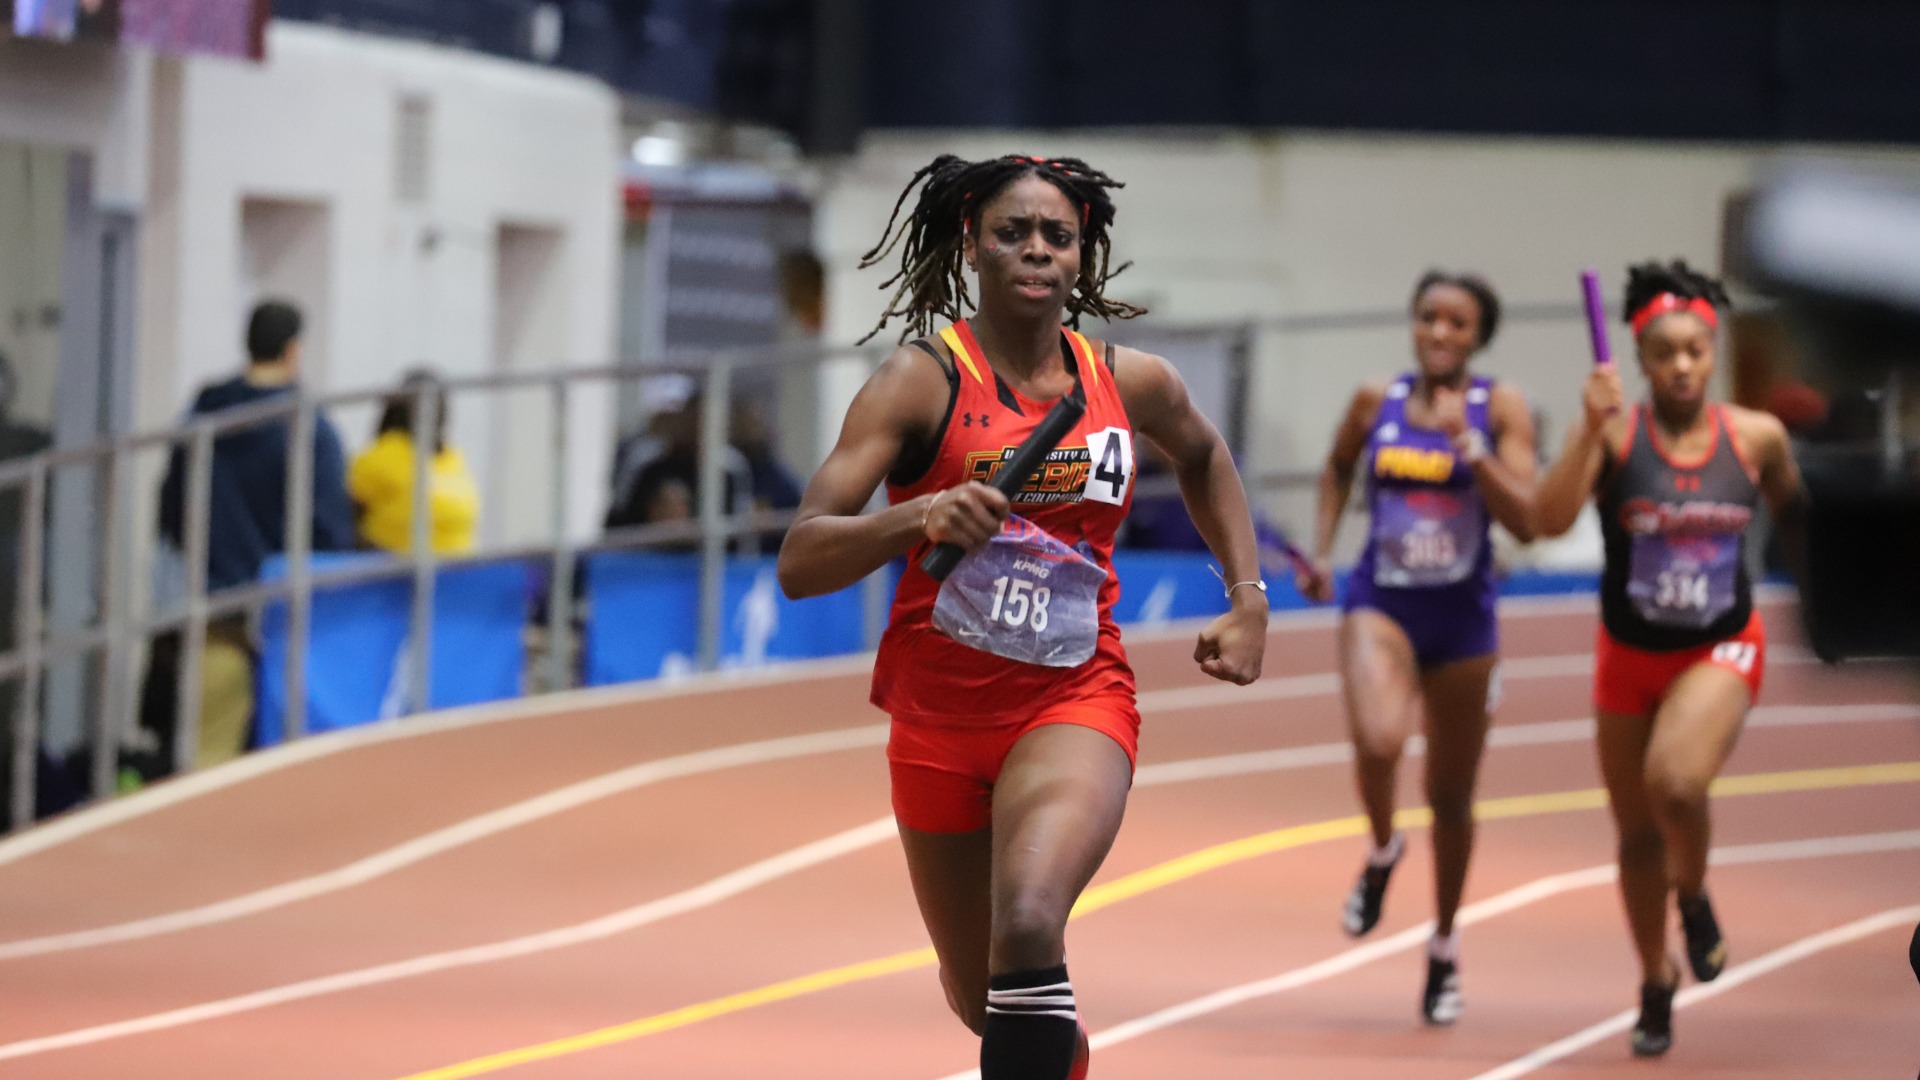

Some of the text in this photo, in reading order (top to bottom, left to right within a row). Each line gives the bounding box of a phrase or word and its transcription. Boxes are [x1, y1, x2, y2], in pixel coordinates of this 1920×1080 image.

[1094, 431, 1125, 499] 4
[1012, 558, 1050, 579] KPMG
[991, 575, 1051, 633] 158
